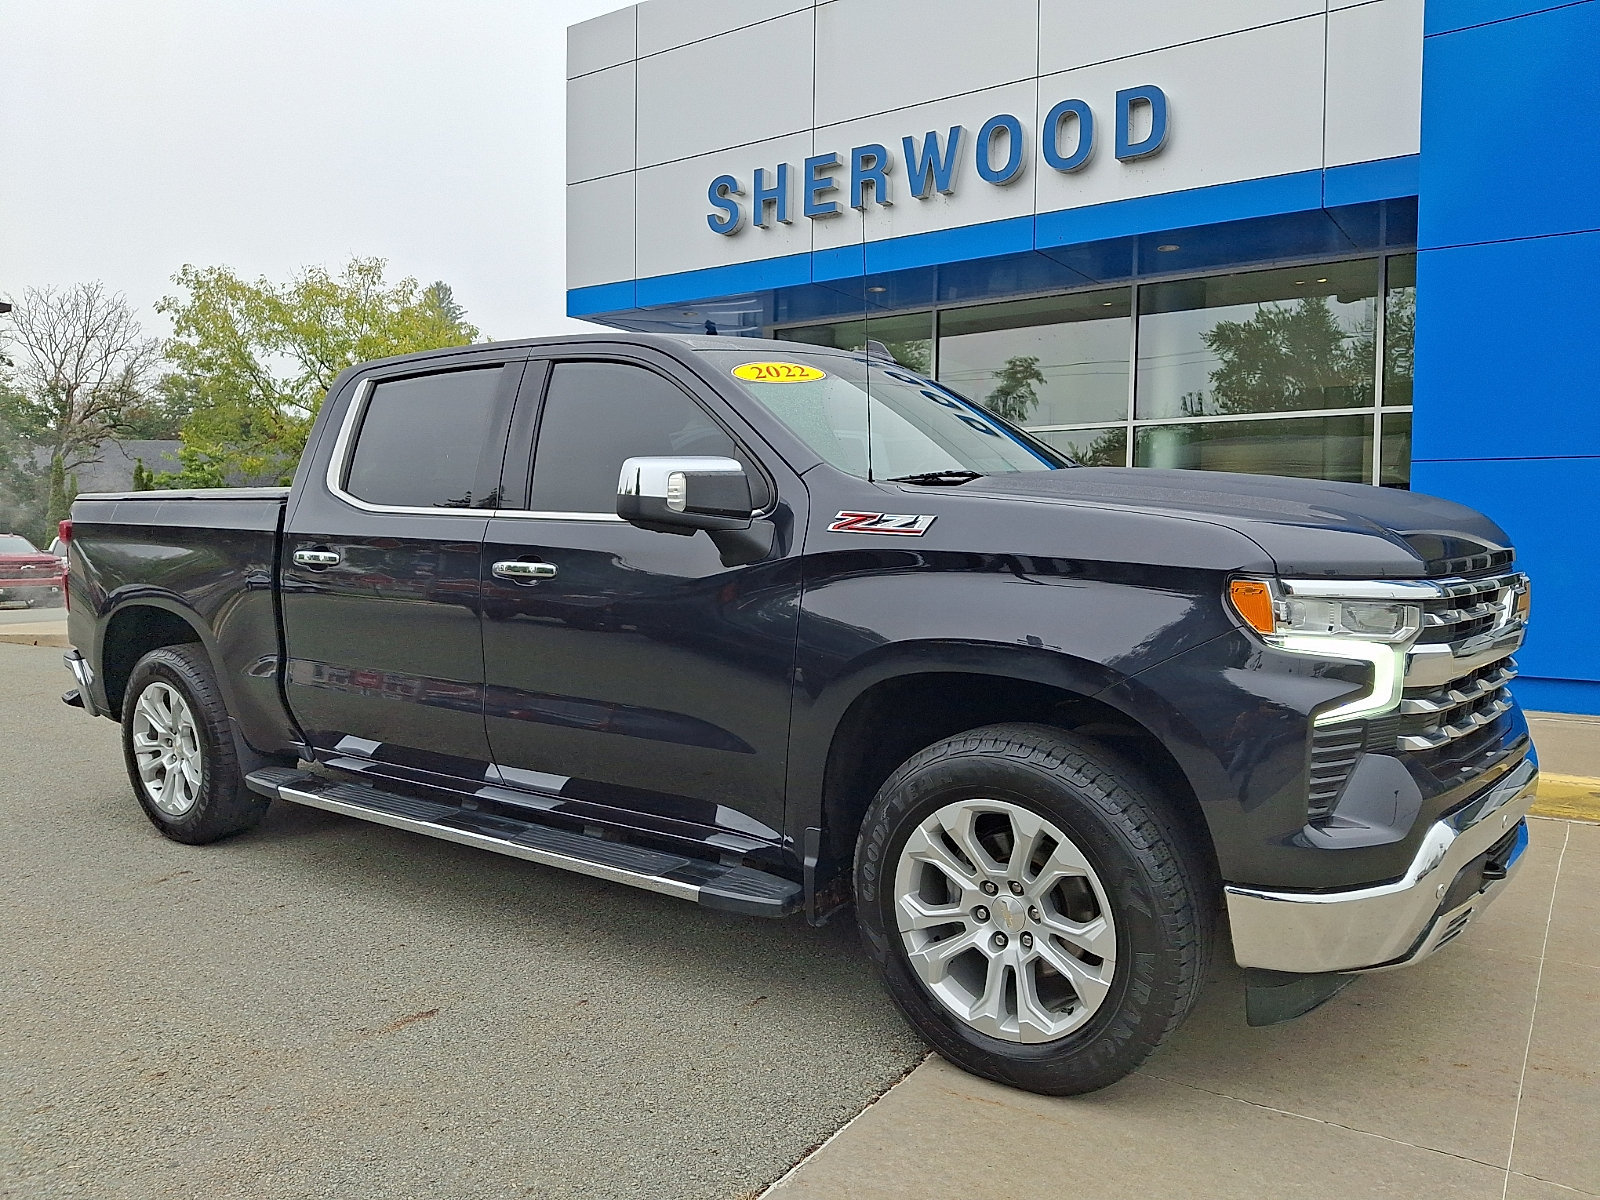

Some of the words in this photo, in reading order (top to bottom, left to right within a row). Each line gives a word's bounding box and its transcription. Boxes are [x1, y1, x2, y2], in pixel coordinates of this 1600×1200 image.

[706, 84, 1171, 236] SHERWOOD
[750, 365, 810, 379] 2022
[827, 510, 938, 537] Z71
